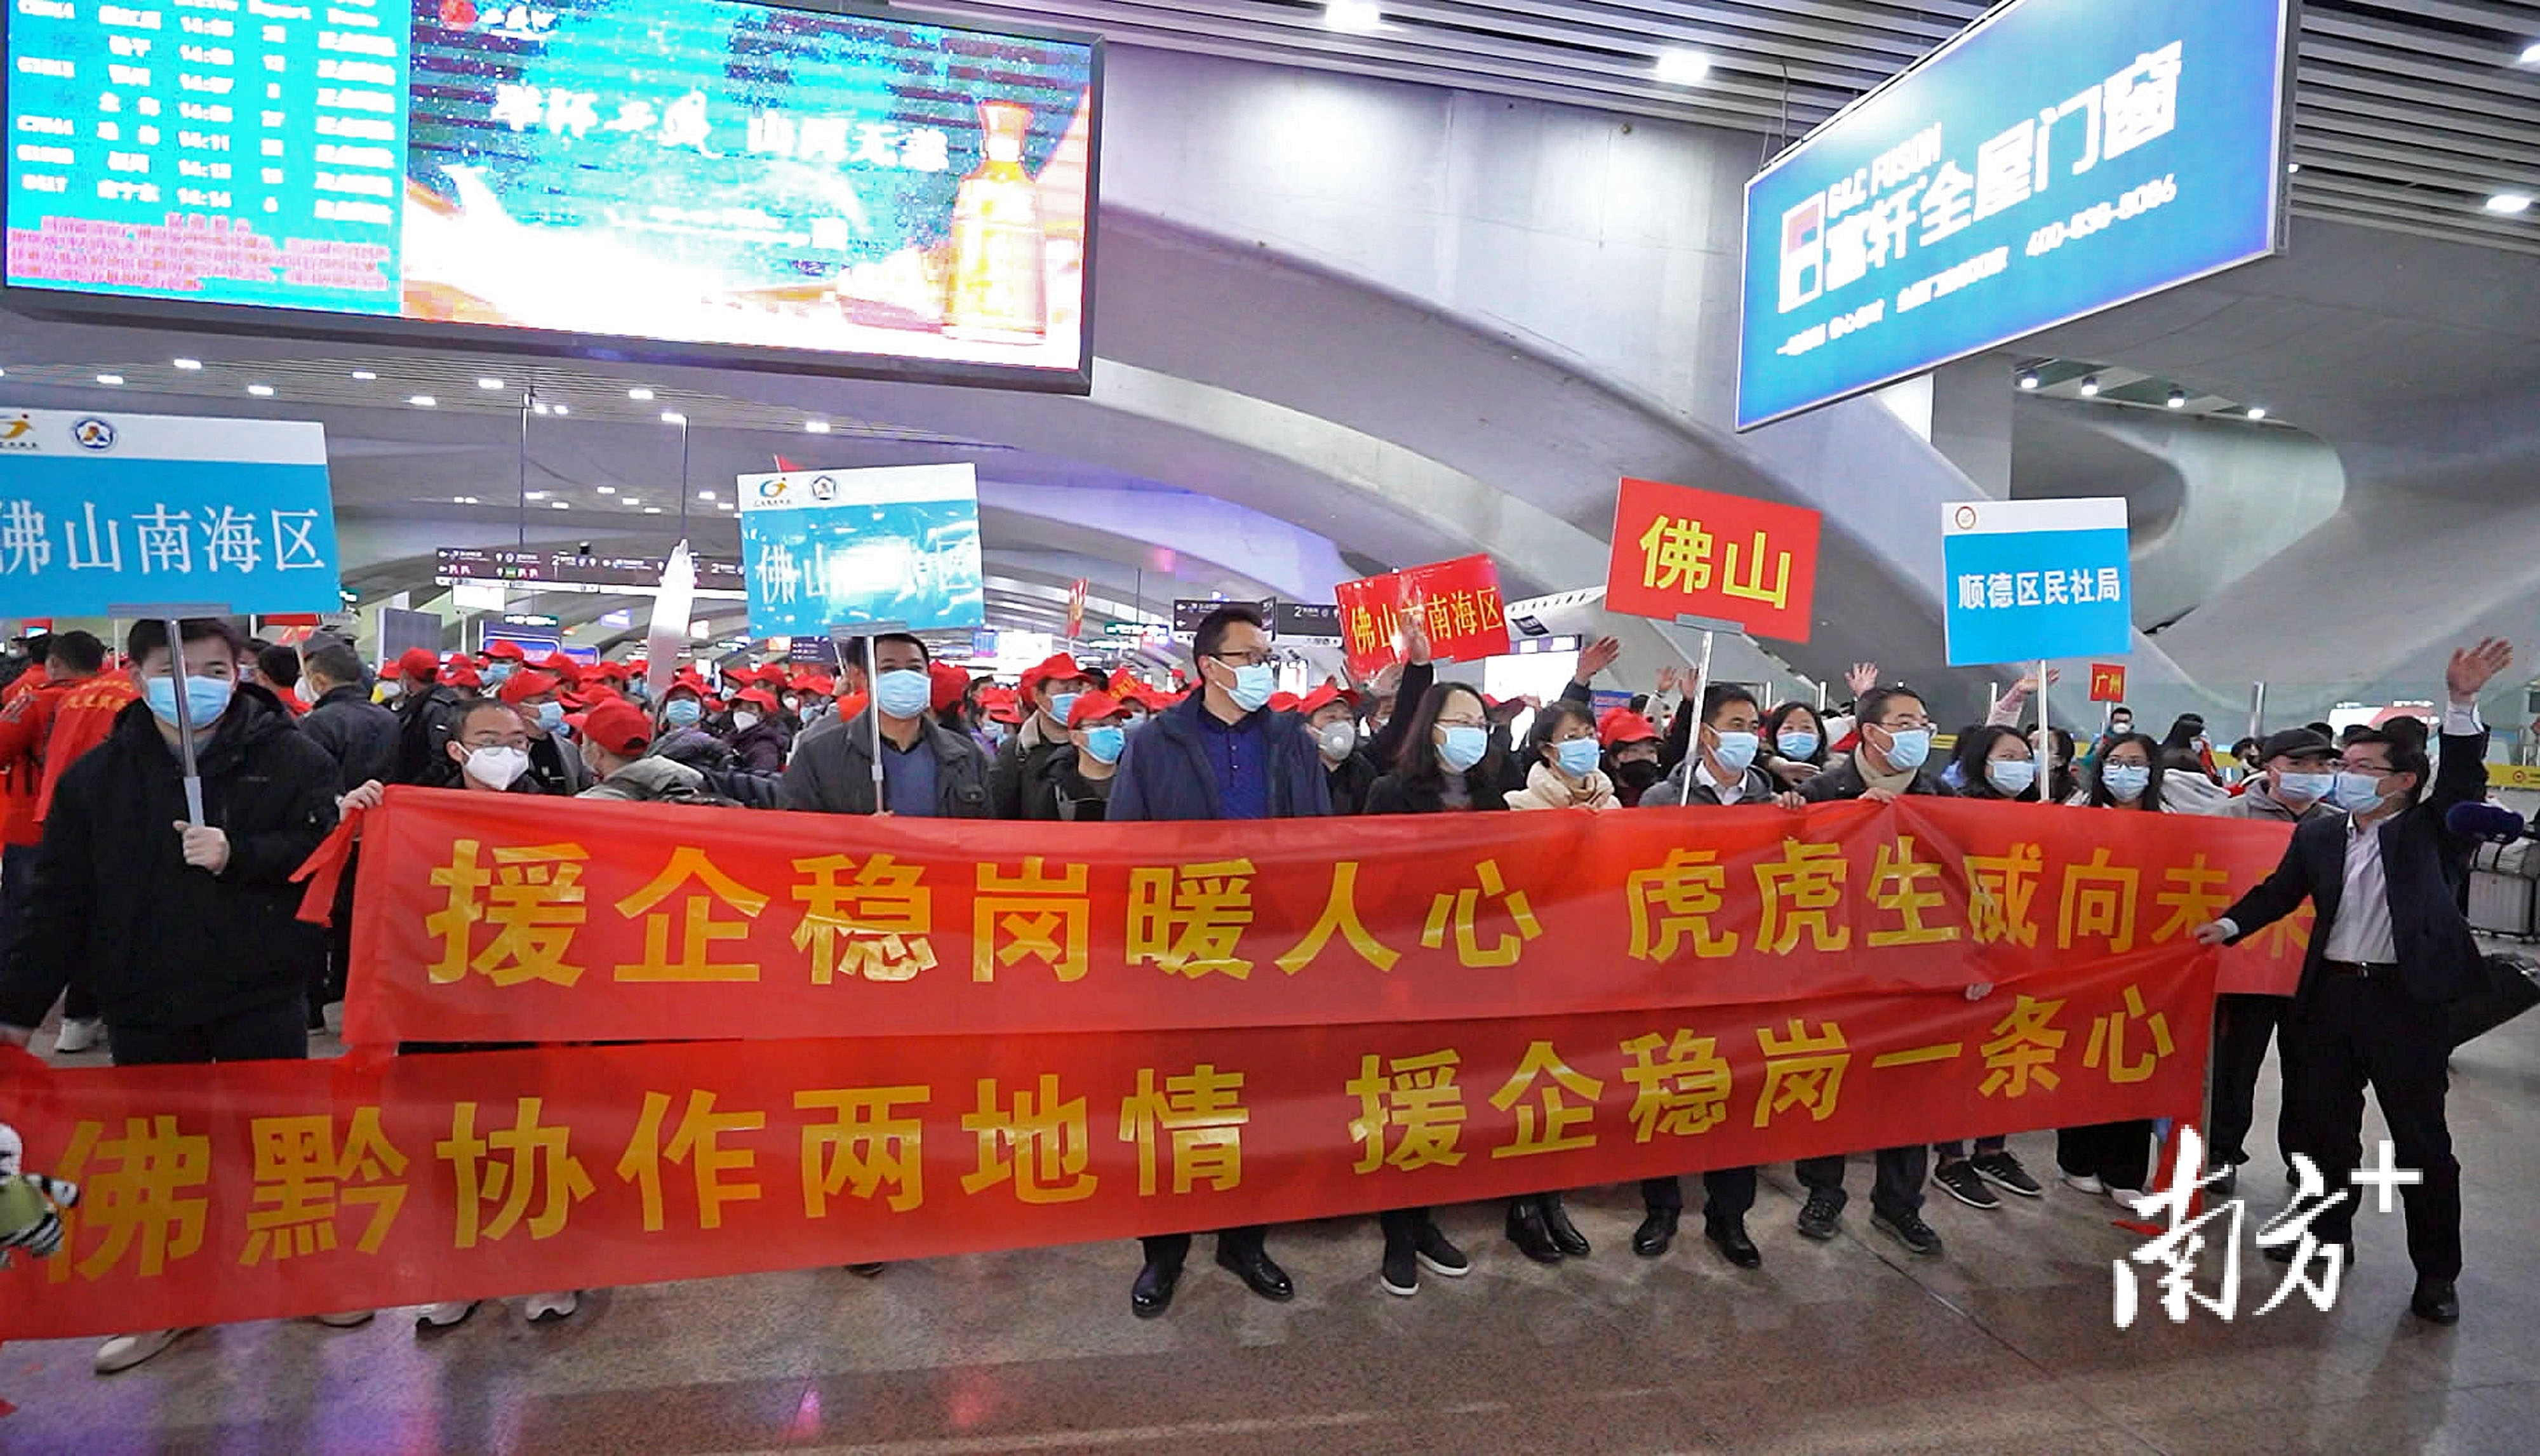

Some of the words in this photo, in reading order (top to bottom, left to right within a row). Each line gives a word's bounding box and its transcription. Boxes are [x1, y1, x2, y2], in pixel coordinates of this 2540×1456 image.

[0, 500, 325, 575] 佛山南海区
[1640, 515, 1792, 610] 佛山
[1958, 568, 2121, 610] 顺德区民社局
[2095, 674, 2122, 695] 广州
[426, 839, 1543, 987] 援企稳岗暖人心
[47, 1064, 1250, 1283] 佛黔协作两地情
[1346, 984, 2175, 1176] 援企稳岗一条心
